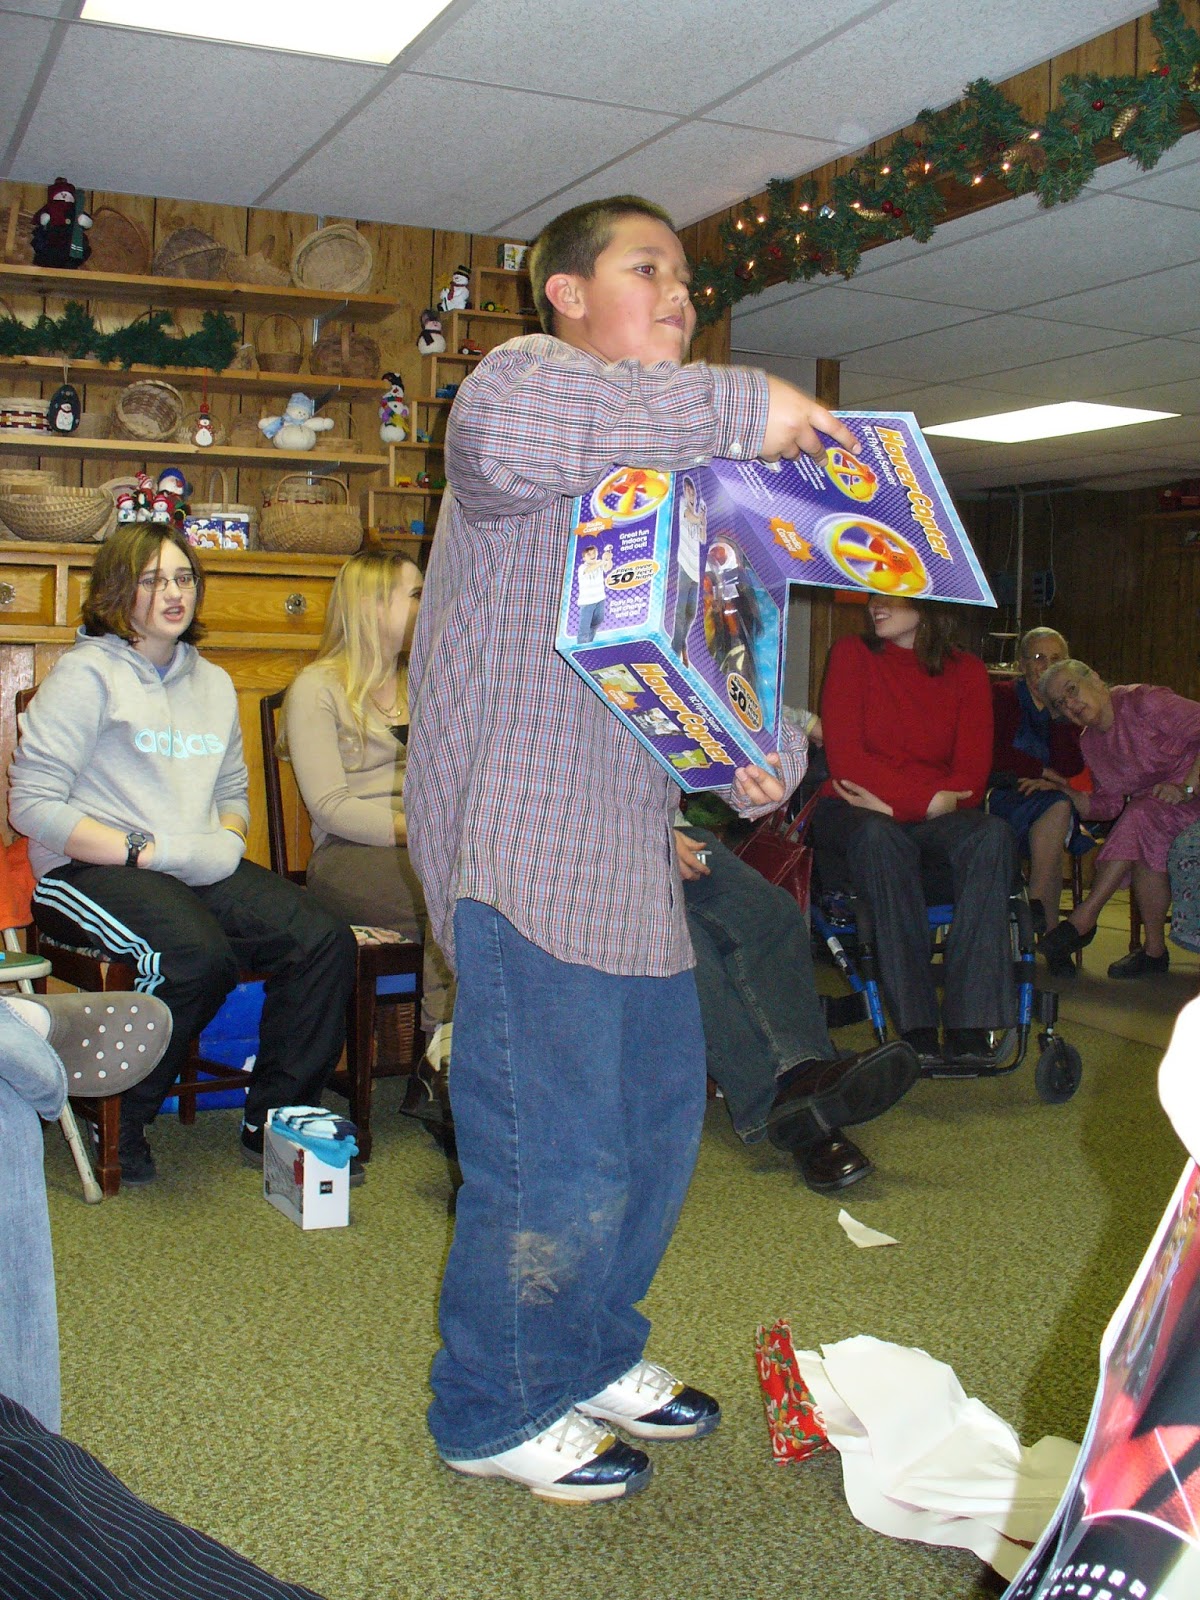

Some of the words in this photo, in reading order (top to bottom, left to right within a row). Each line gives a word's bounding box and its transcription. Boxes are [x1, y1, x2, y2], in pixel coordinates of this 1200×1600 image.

[861, 425, 873, 438] RC
[867, 435, 884, 459] Flying
[880, 458, 897, 486] Saucer
[619, 532, 638, 540] Great
[638, 529, 650, 537] fun
[776, 527, 797, 551] Control
[608, 571, 635, 586] 30
[615, 610, 628, 618] and
[622, 602, 647, 613] charge
[729, 680, 747, 712] 30
[134, 725, 225, 758] addas
